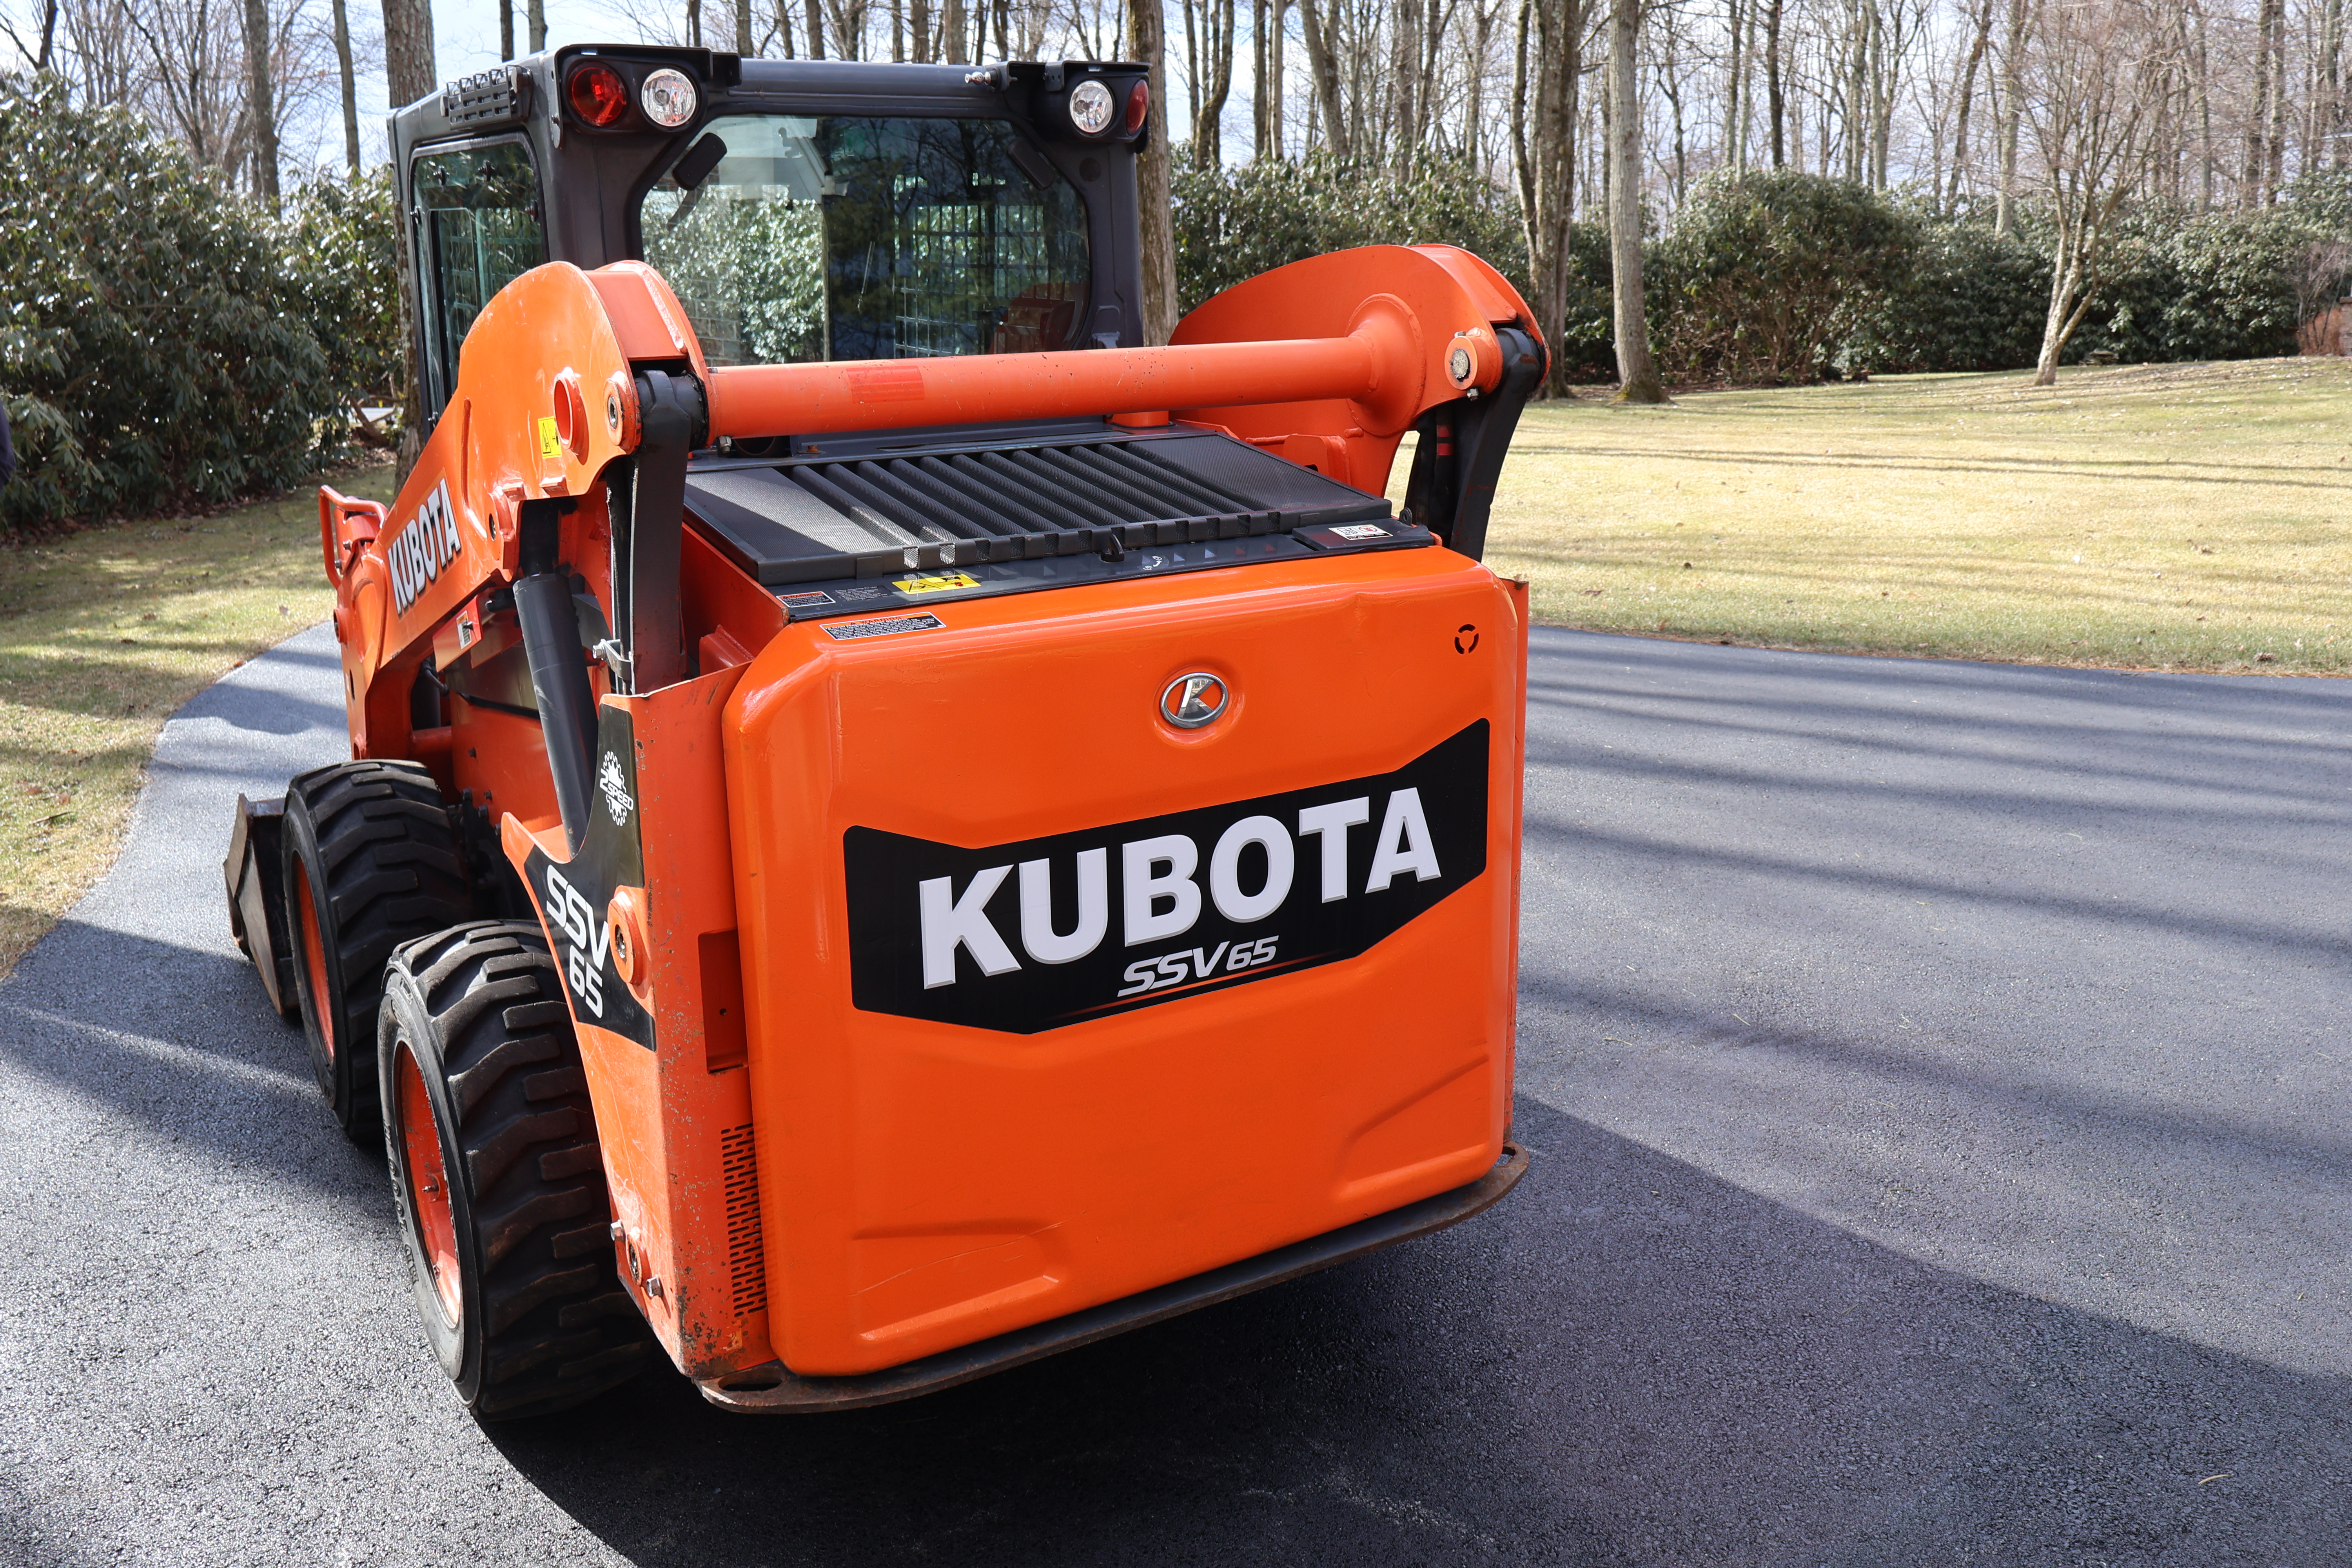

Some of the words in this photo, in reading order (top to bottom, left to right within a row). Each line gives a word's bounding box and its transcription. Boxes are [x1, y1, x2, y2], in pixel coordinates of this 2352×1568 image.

[388, 478, 461, 615] KUBOTA
[600, 768, 609, 792] 2
[608, 782, 633, 811] SPEED
[546, 864, 609, 971] SSV
[919, 787, 1441, 990] KUBOTA
[569, 945, 603, 1018] 65
